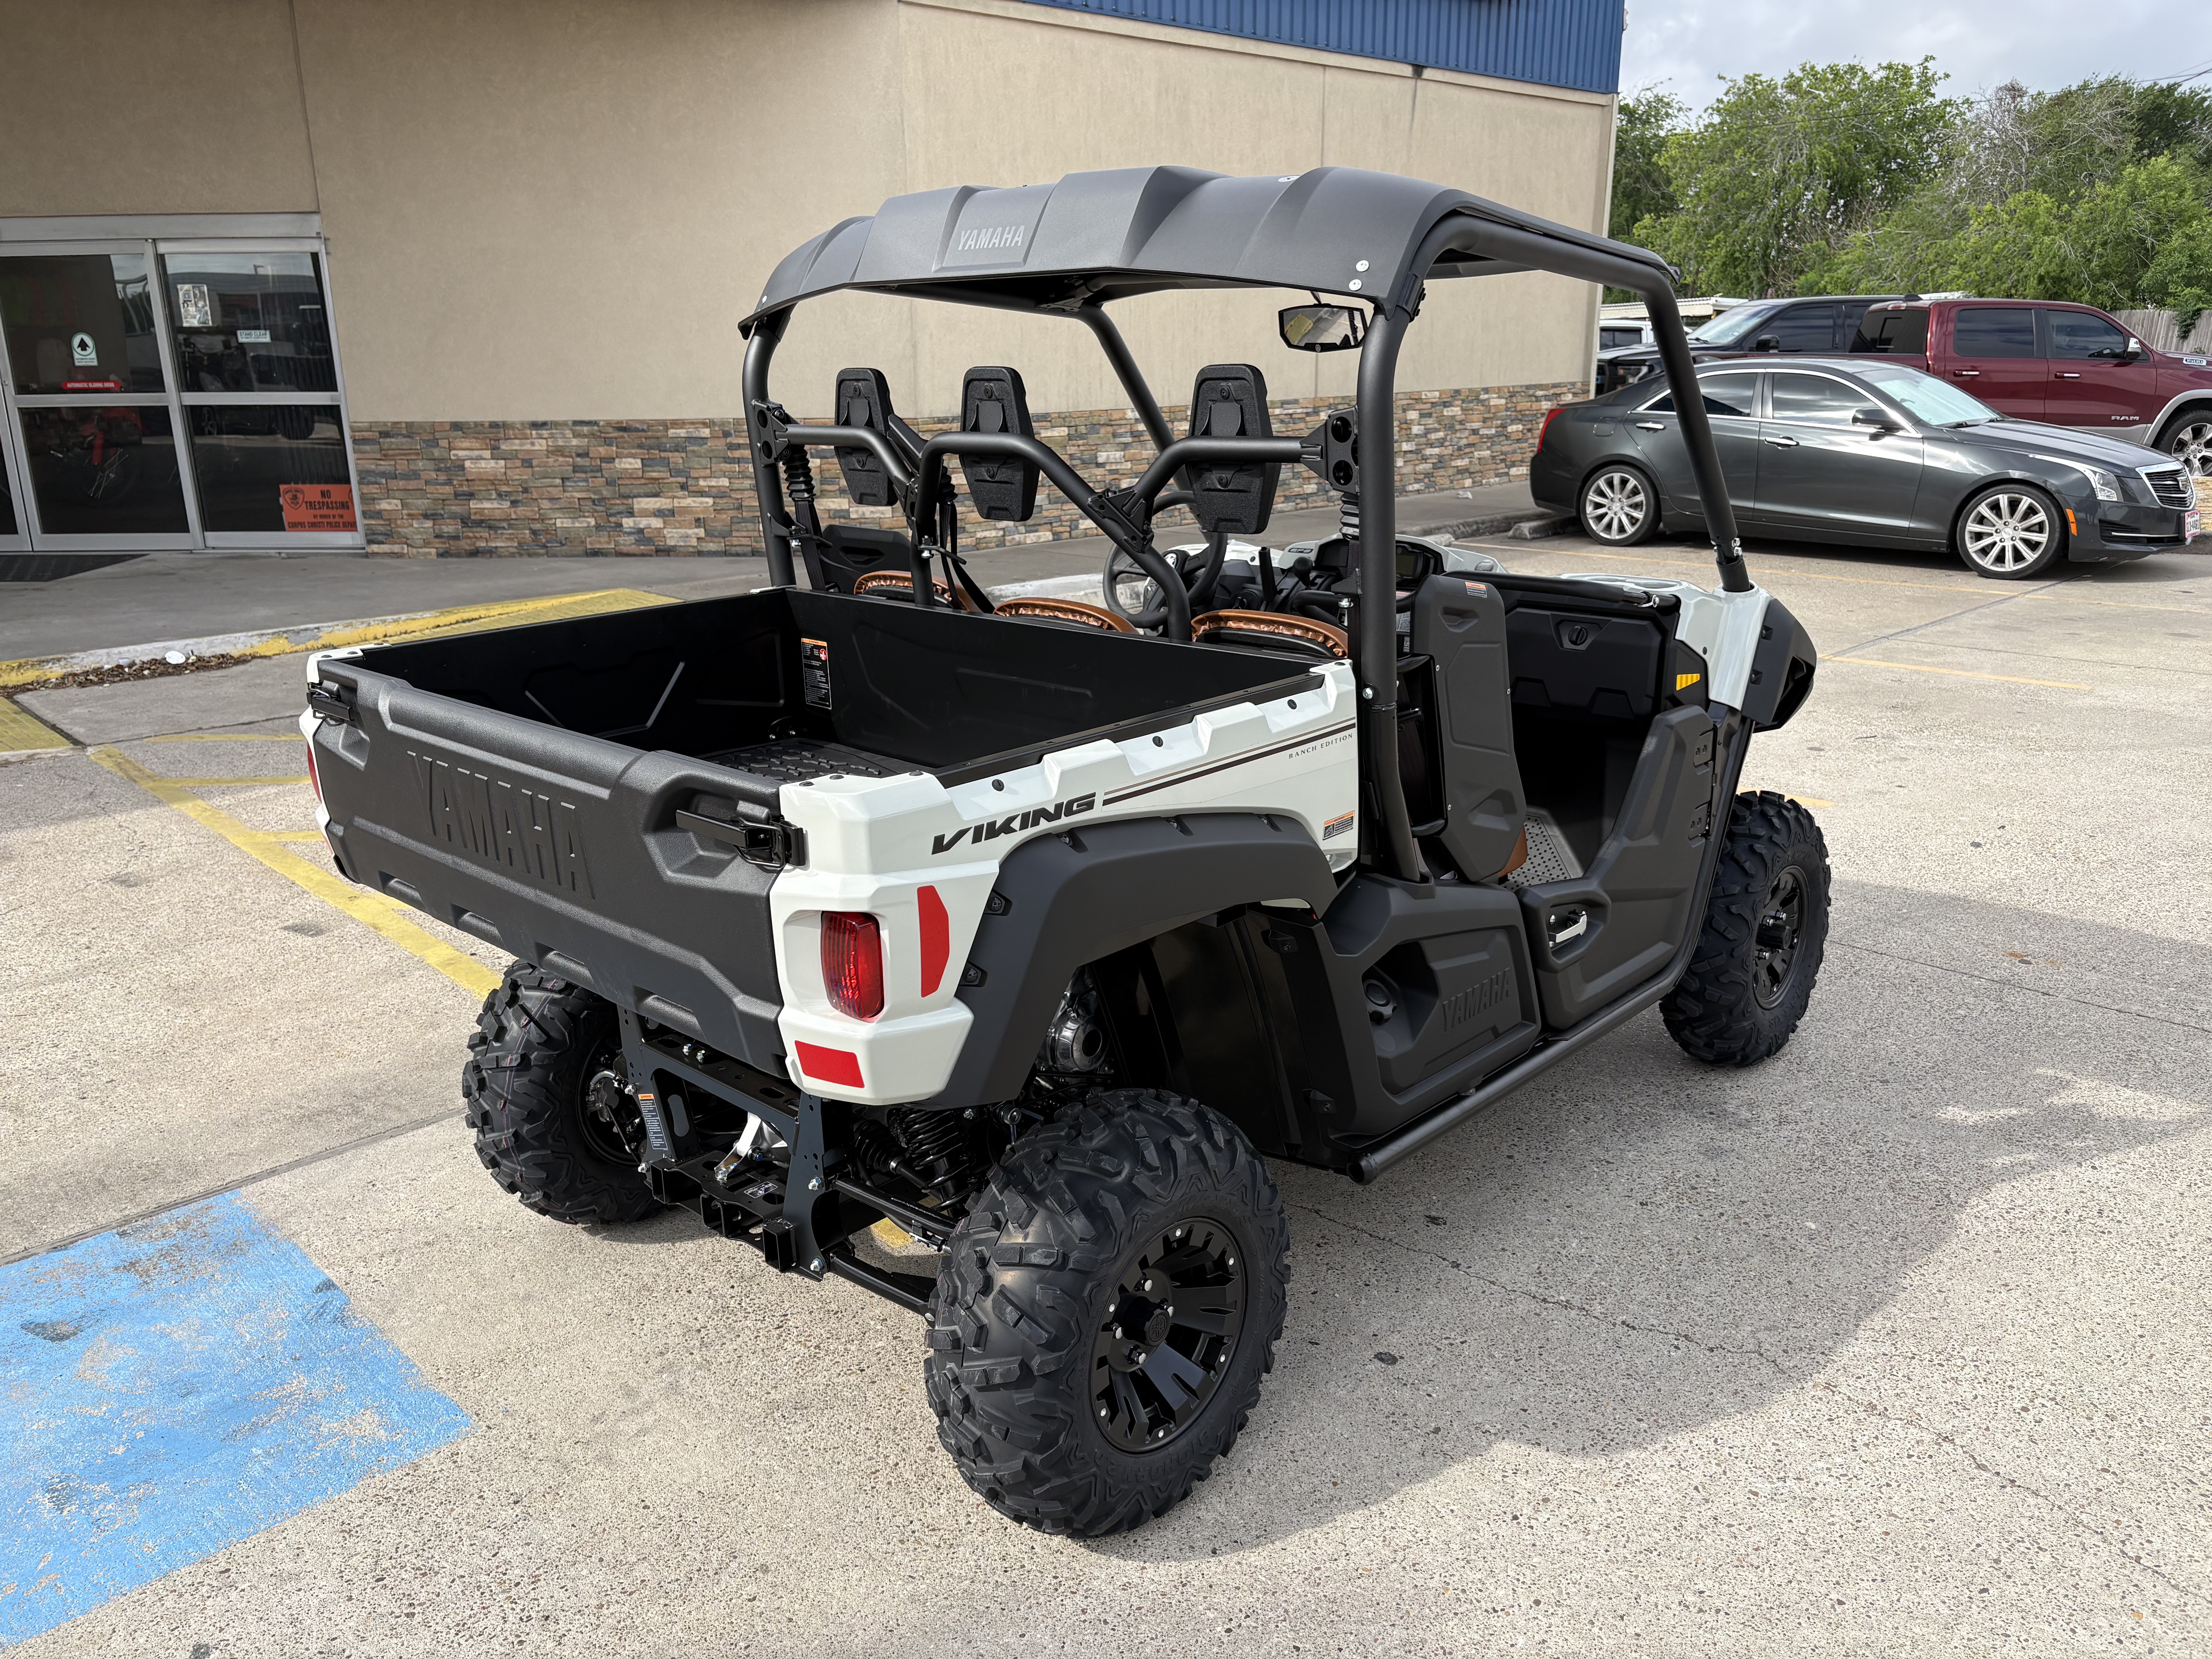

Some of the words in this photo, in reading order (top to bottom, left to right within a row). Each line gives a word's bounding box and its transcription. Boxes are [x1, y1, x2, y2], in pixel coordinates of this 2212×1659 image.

[958, 225, 1025, 251] YAMAHA
[304, 500, 350, 510] TRESPASSING
[320, 489, 331, 499] NO
[1289, 745, 1317, 759] RANCH
[1321, 733, 1353, 749] EDITION
[407, 750, 596, 900] YAMAHA
[931, 792, 1096, 855] VIKING
[1442, 967, 1510, 1032] YAMAHA
